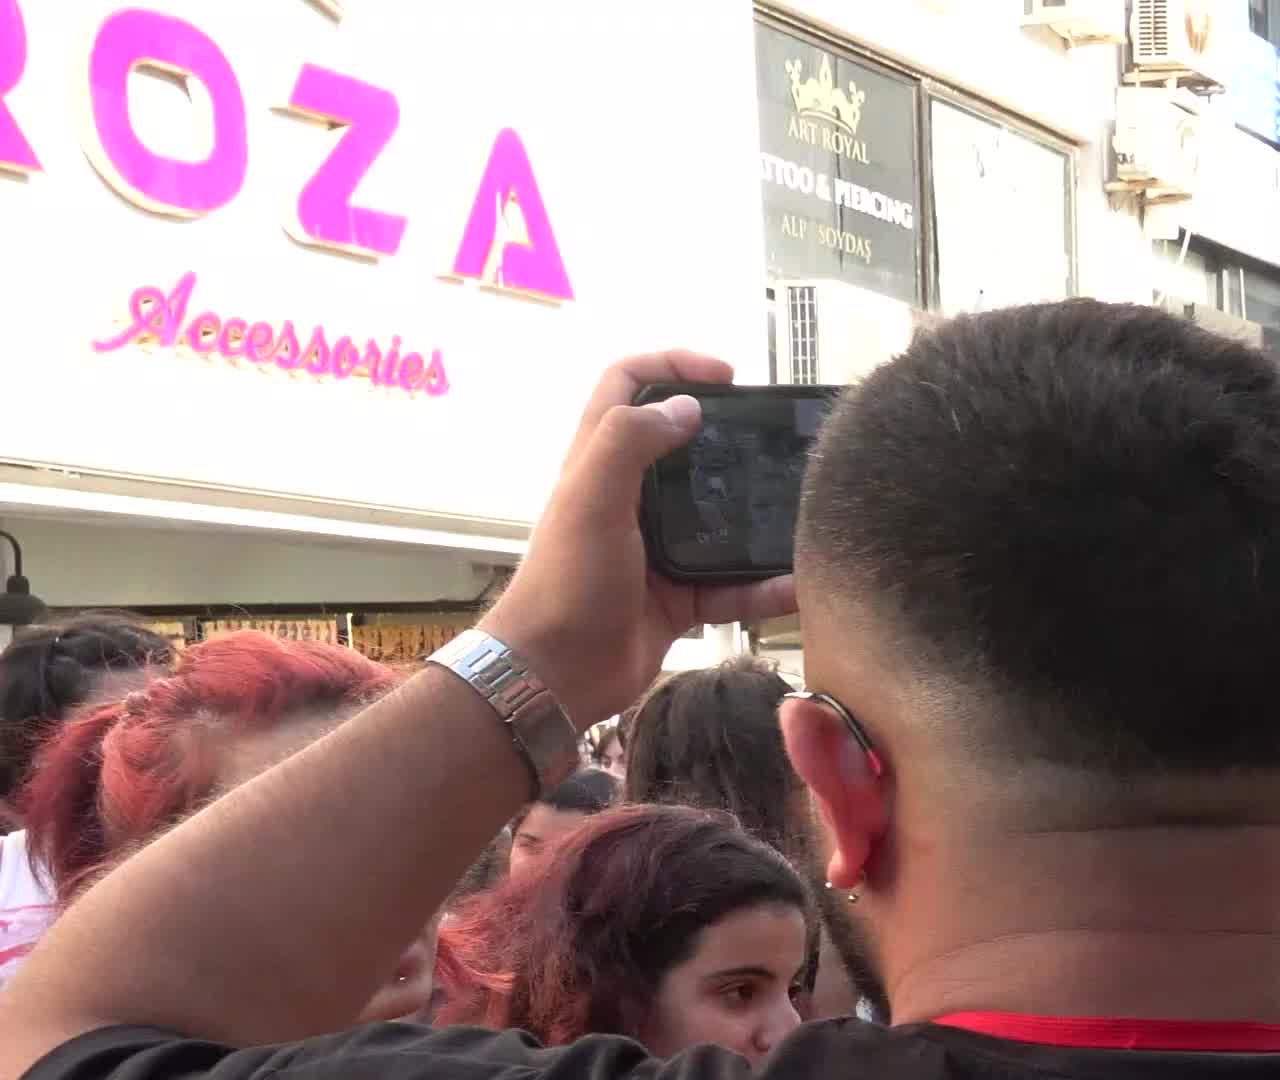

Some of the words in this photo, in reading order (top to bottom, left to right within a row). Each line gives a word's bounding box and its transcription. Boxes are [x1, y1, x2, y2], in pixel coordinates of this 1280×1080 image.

[788, 114, 817, 145] ART
[822, 127, 870, 164] ROYAL
[815, 172, 832, 202] &
[834, 176, 914, 230] PIERCING
[92, 272, 451, 397] Accessories
